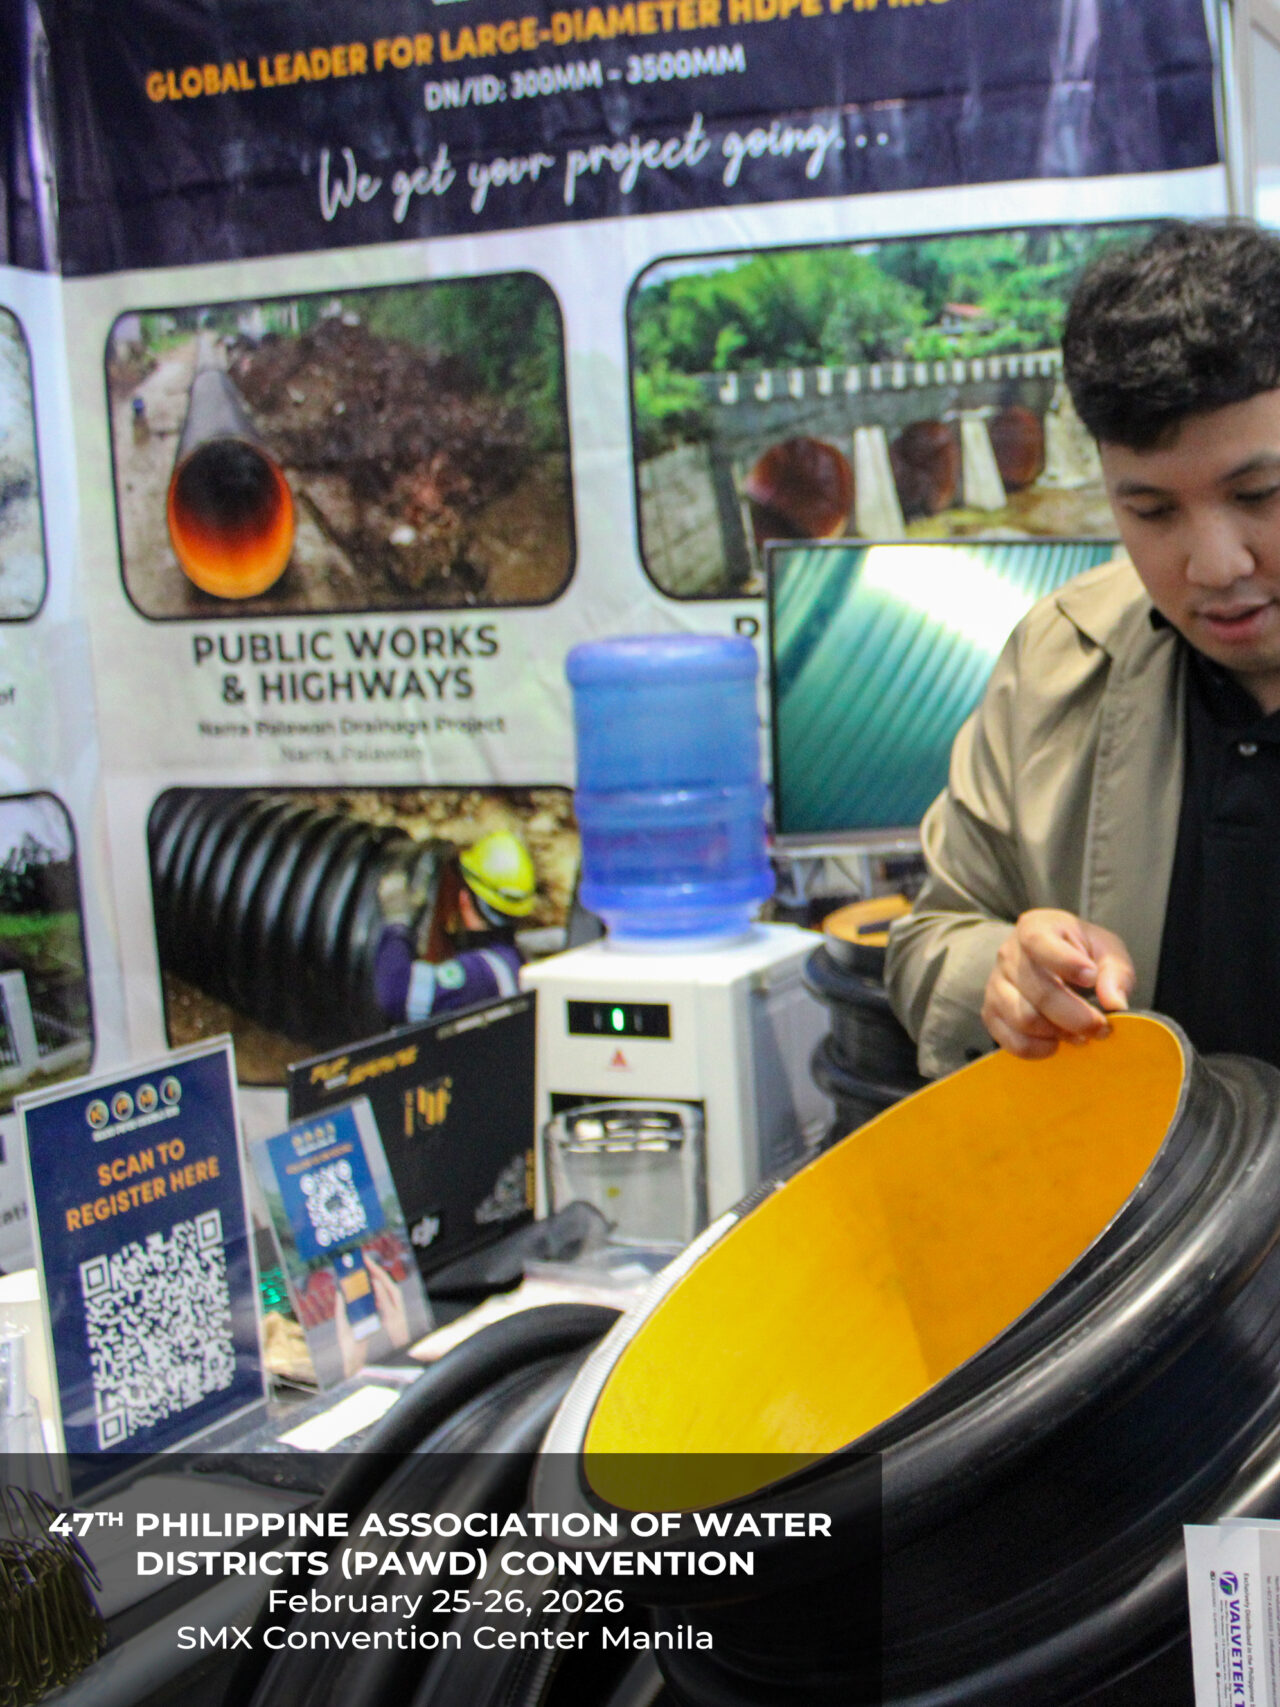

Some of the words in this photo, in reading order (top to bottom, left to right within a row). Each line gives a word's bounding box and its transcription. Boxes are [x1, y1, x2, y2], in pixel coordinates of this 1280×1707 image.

[146, 60, 255, 102] GLOBAL
[258, 42, 367, 87] LEADER
[373, 32, 434, 71] FOR
[439, 0, 721, 62] LARGE-DIAMETER
[424, 74, 507, 111] DN/ID:
[510, 59, 603, 99] 300MM
[626, 43, 746, 84] 3500MM
[319, 147, 382, 221] We
[391, 142, 457, 224] get
[468, 152, 555, 214] your
[564, 112, 711, 206] project
[193, 631, 334, 665] PUBLIC
[346, 624, 499, 660] WORKS
[222, 674, 245, 703] &
[260, 667, 474, 702] HIGHWAYS
[435, 716, 505, 735] Project
[65, 1177, 167, 1232] REGISTER
[169, 1155, 220, 1193] HERE
[97, 1148, 155, 1187] SCAN
[156, 1137, 185, 1165] TO
[1229, 1599, 1245, 1696] VALVETEK
